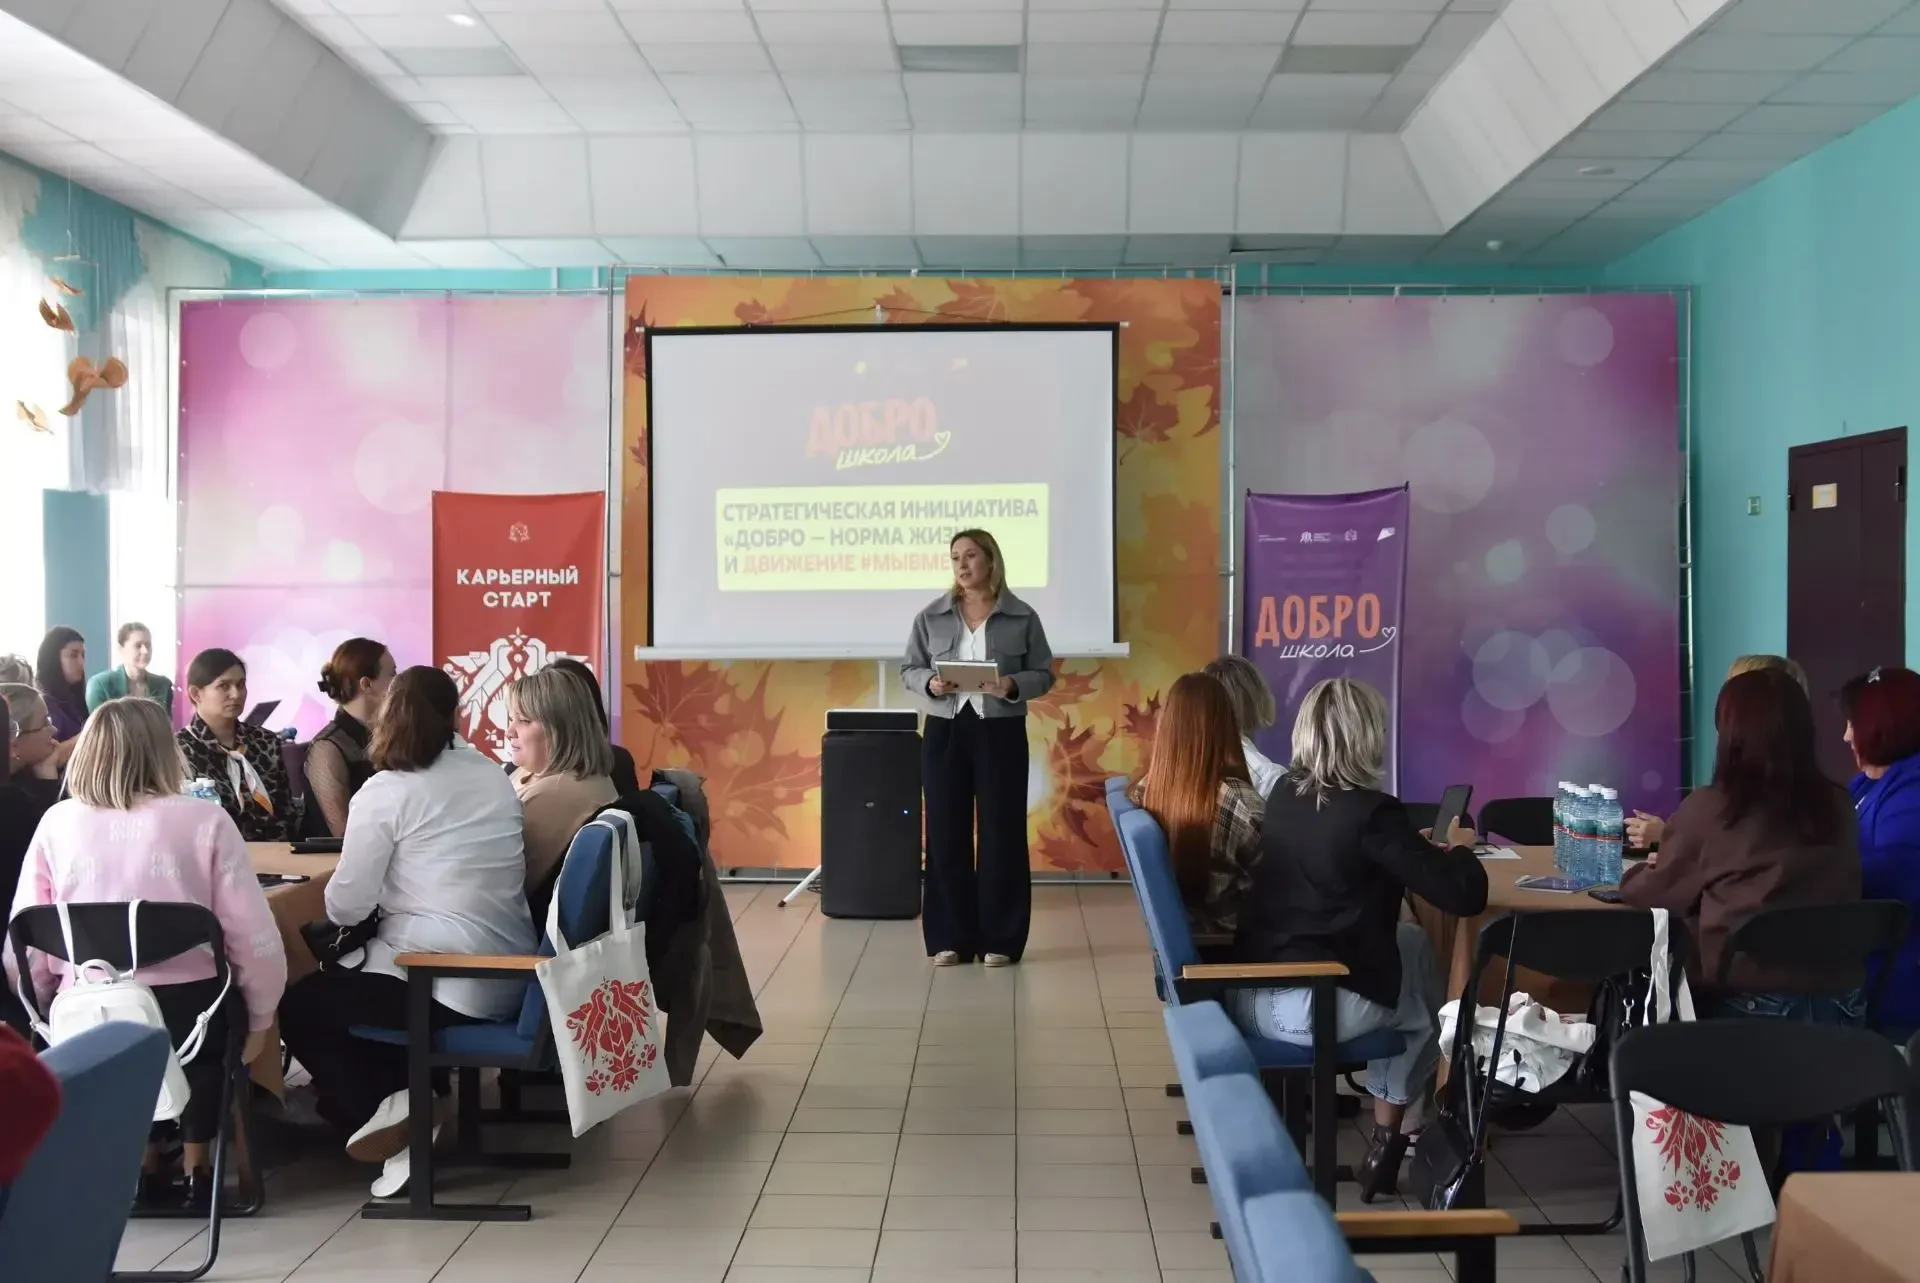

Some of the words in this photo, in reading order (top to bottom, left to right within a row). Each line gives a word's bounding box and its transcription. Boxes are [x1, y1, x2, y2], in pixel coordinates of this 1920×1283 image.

[805, 396, 937, 459] ДОБРО
[836, 444, 917, 470] школа
[723, 500, 895, 521] СТРАТЕГИЧЕСКАЯ
[901, 498, 1038, 521] ИНИЦИАТИВА
[724, 528, 806, 551] «ДОБРО
[830, 527, 904, 546] НОРМА
[909, 526, 981, 545] ЖИЗ
[456, 566, 579, 585] КАРЬЕРНЫЙ
[724, 555, 738, 573] И
[743, 554, 856, 575] ДВИЖЕНИЕ
[861, 553, 951, 572] #МЫВМЕ
[482, 591, 551, 608] СТАРТ
[1255, 593, 1381, 648] ДОБРО
[1280, 644, 1355, 659] школа
